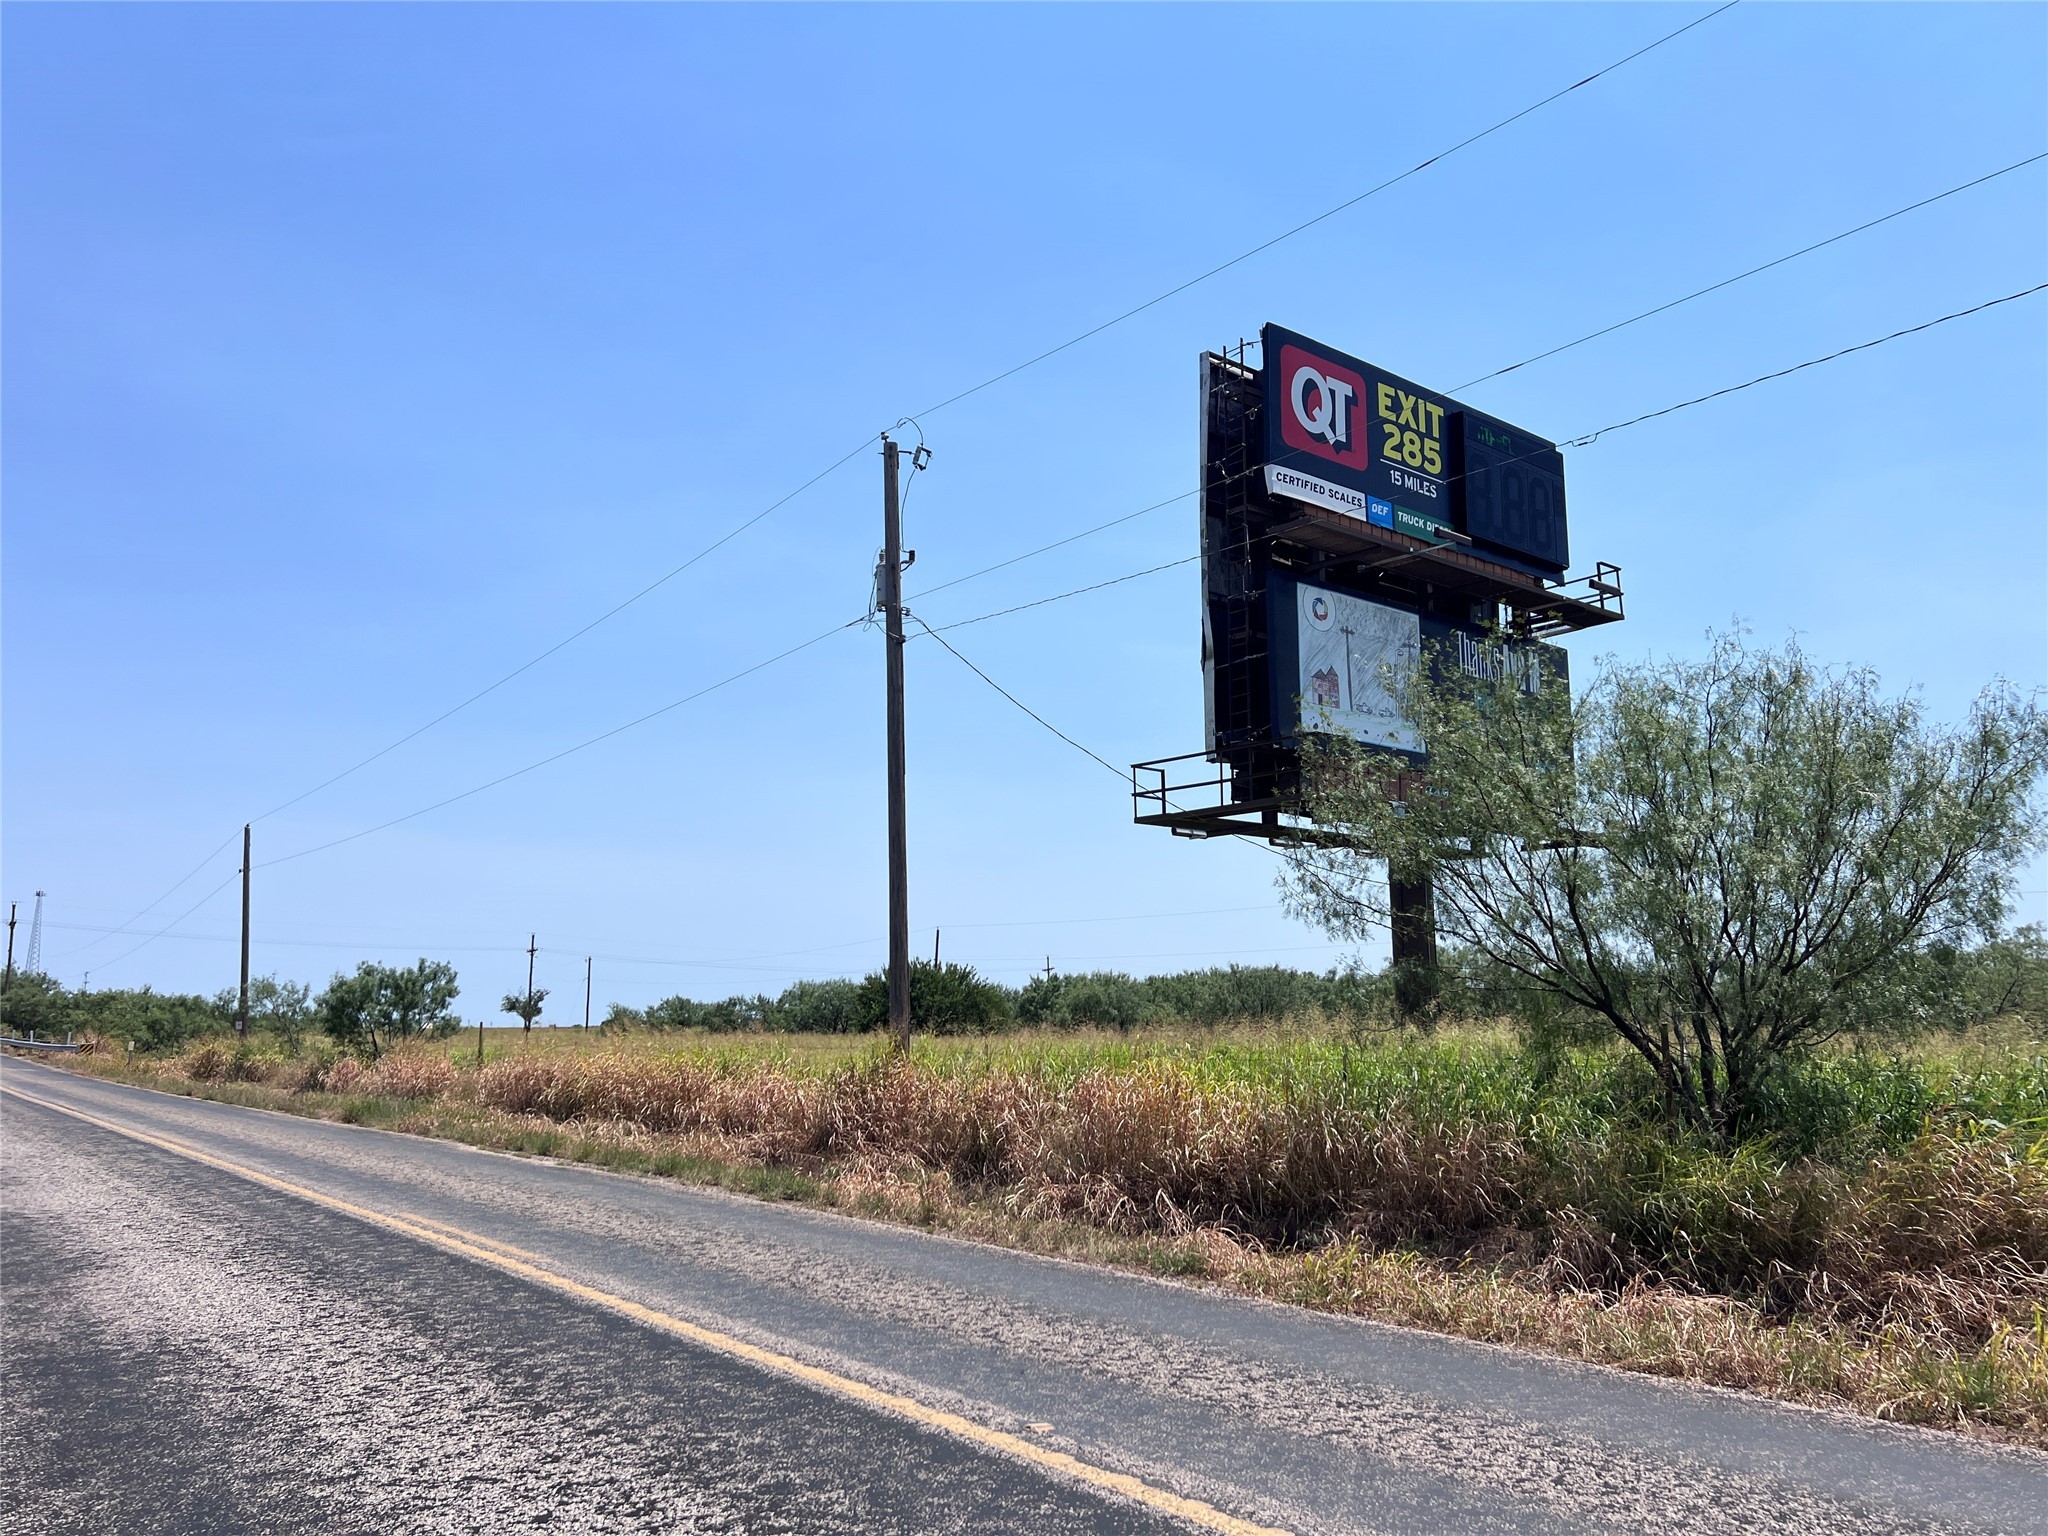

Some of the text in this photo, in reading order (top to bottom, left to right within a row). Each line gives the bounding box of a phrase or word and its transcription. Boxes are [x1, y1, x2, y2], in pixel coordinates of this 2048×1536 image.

[1291, 366, 1352, 445] QT
[1377, 382, 1444, 438] EXIT
[1383, 424, 1442, 474] 285
[1276, 472, 1362, 508] CERTIFIED SCALES
[1390, 469, 1437, 498] 15 MILES
[1371, 503, 1389, 516] DEF
[1397, 511, 1425, 529] TRUCK
